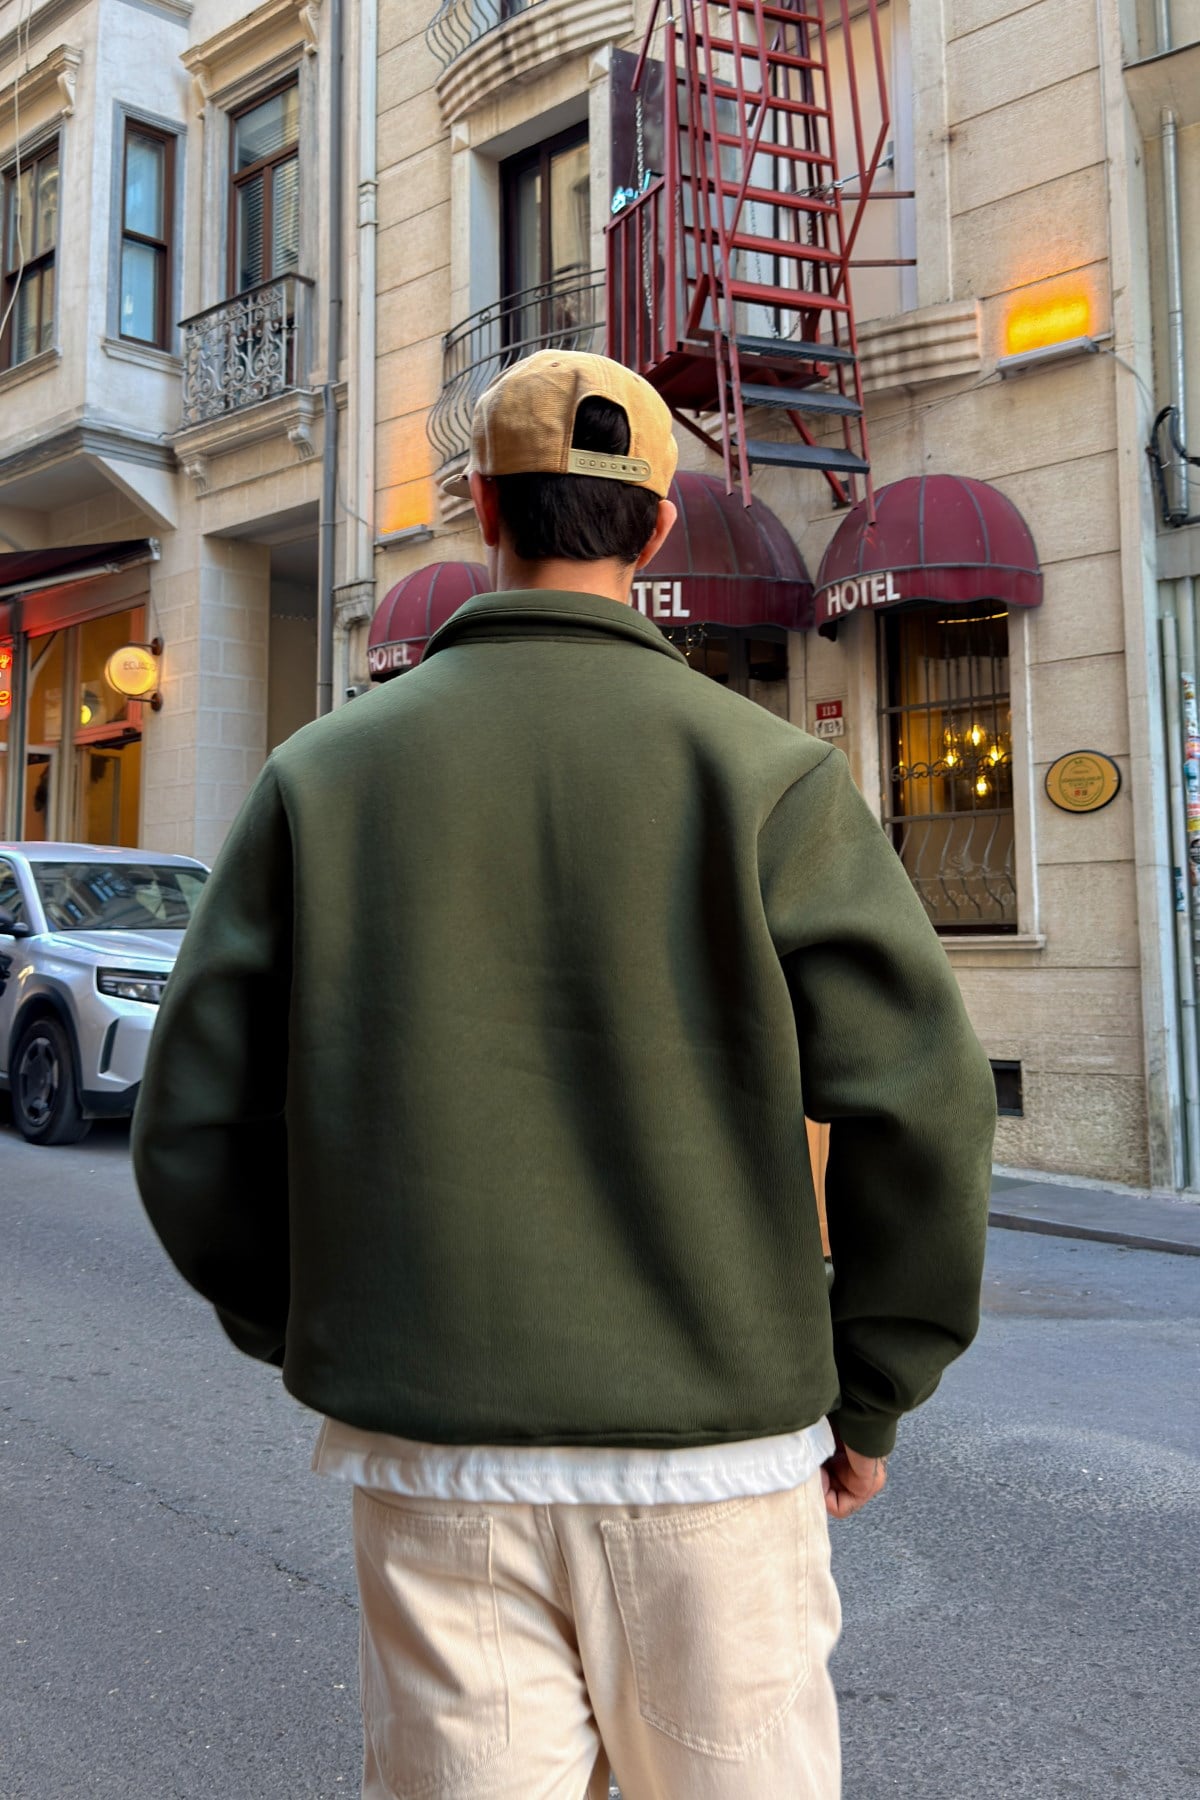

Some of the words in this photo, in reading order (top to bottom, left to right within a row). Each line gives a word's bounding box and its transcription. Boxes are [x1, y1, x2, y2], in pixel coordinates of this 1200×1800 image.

[629, 581, 690, 618] TEL
[827, 572, 901, 616] HOTEL
[369, 643, 412, 672] HOTEL
